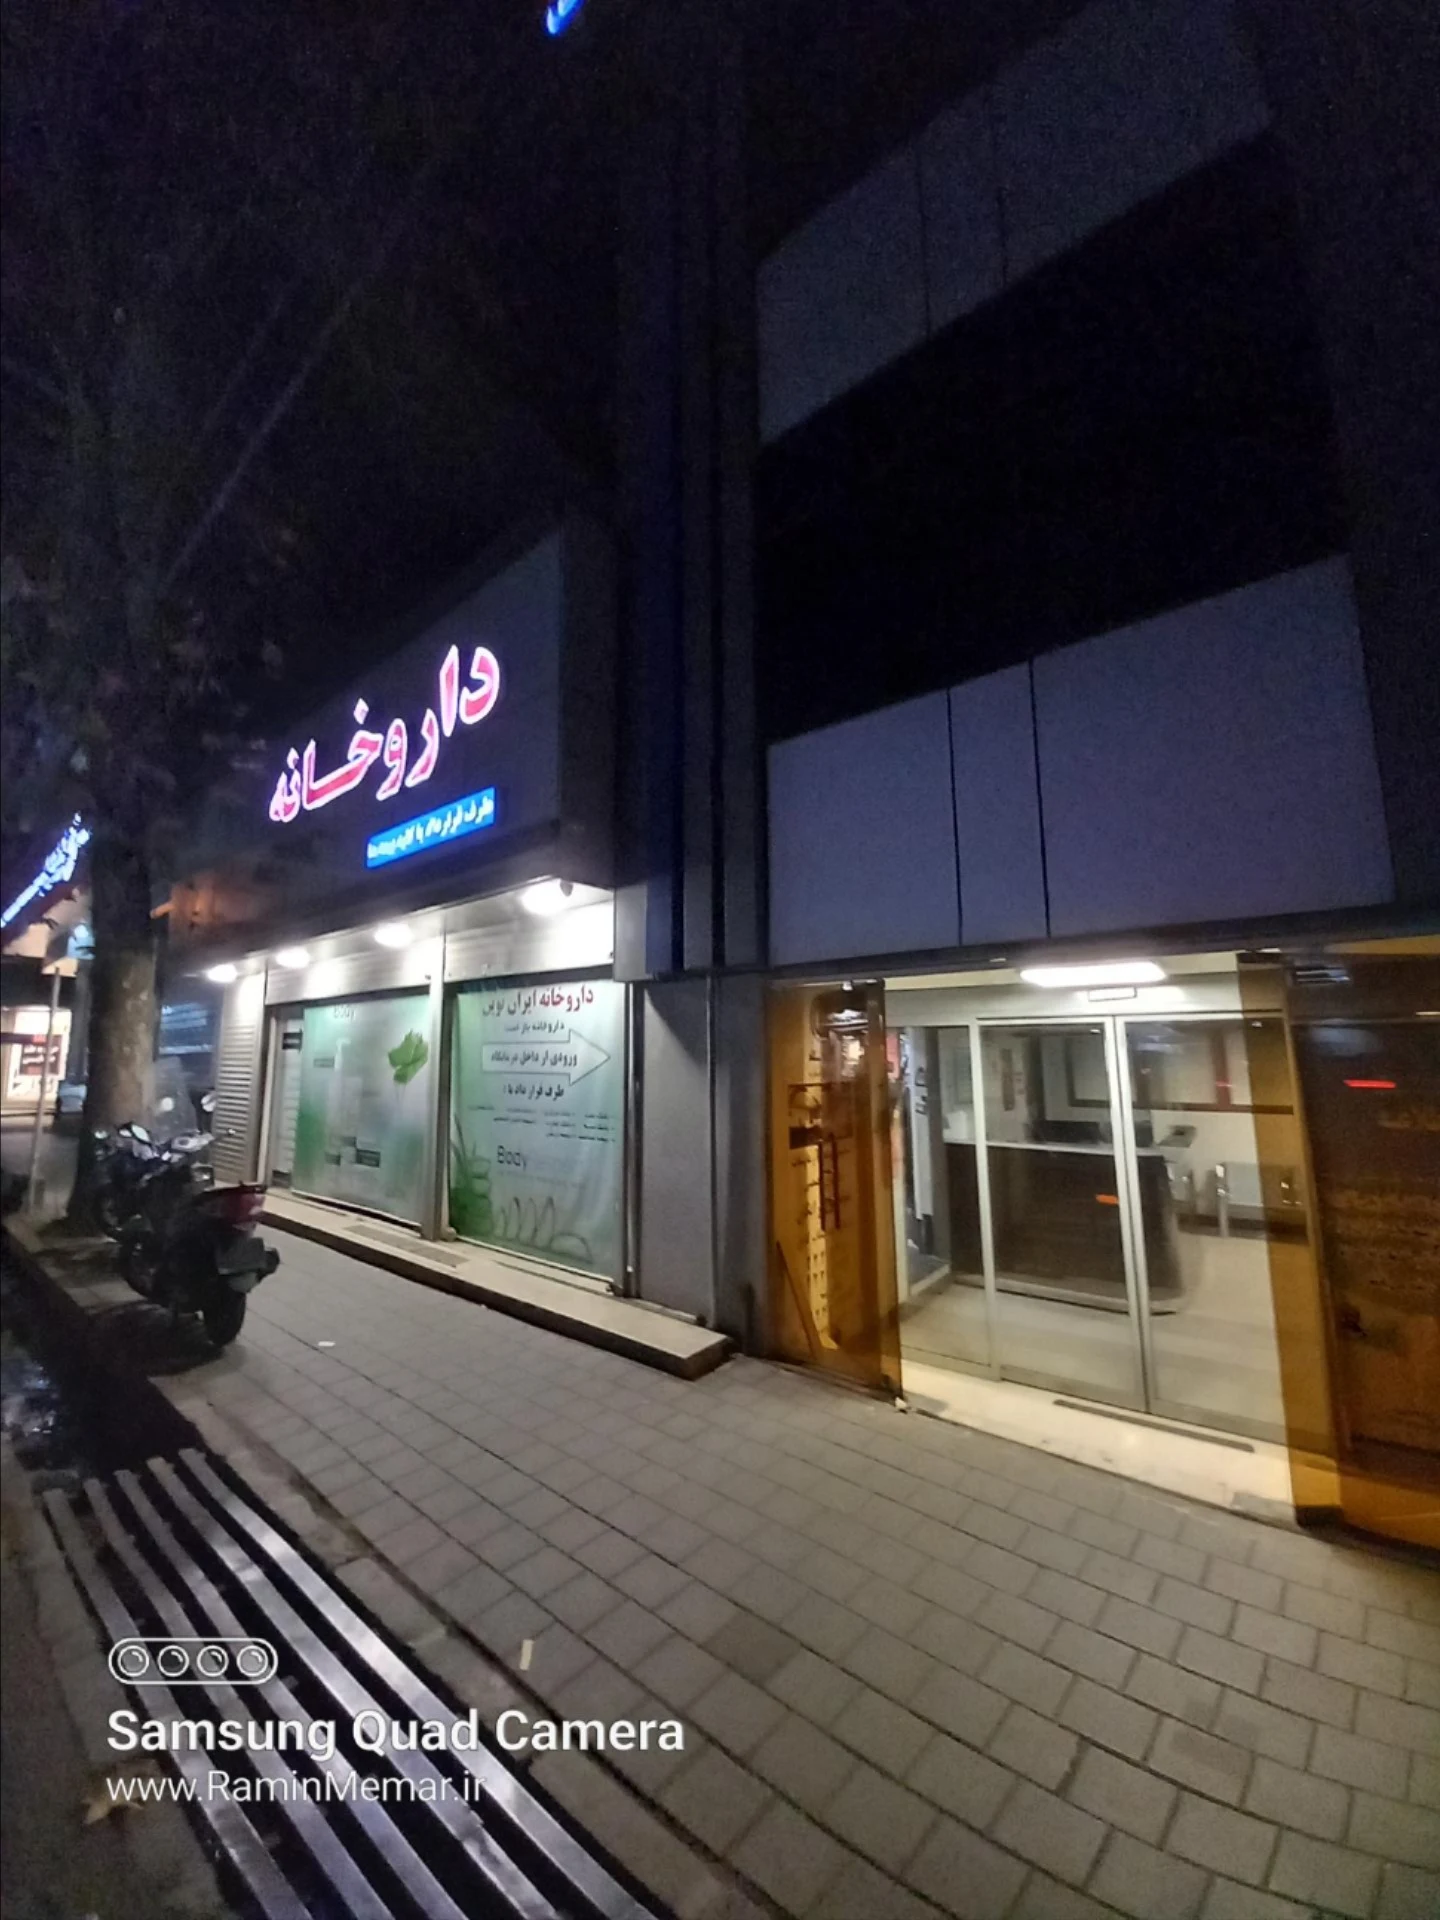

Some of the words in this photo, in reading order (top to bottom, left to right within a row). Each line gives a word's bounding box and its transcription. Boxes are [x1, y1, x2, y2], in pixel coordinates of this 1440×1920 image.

[269, 644, 500, 823] داروخانه
[507, 989, 537, 1016] ایران
[539, 985, 594, 1012] داروخانه
[550, 1052, 578, 1067] ورودی
[545, 1083, 565, 1101] طرف
